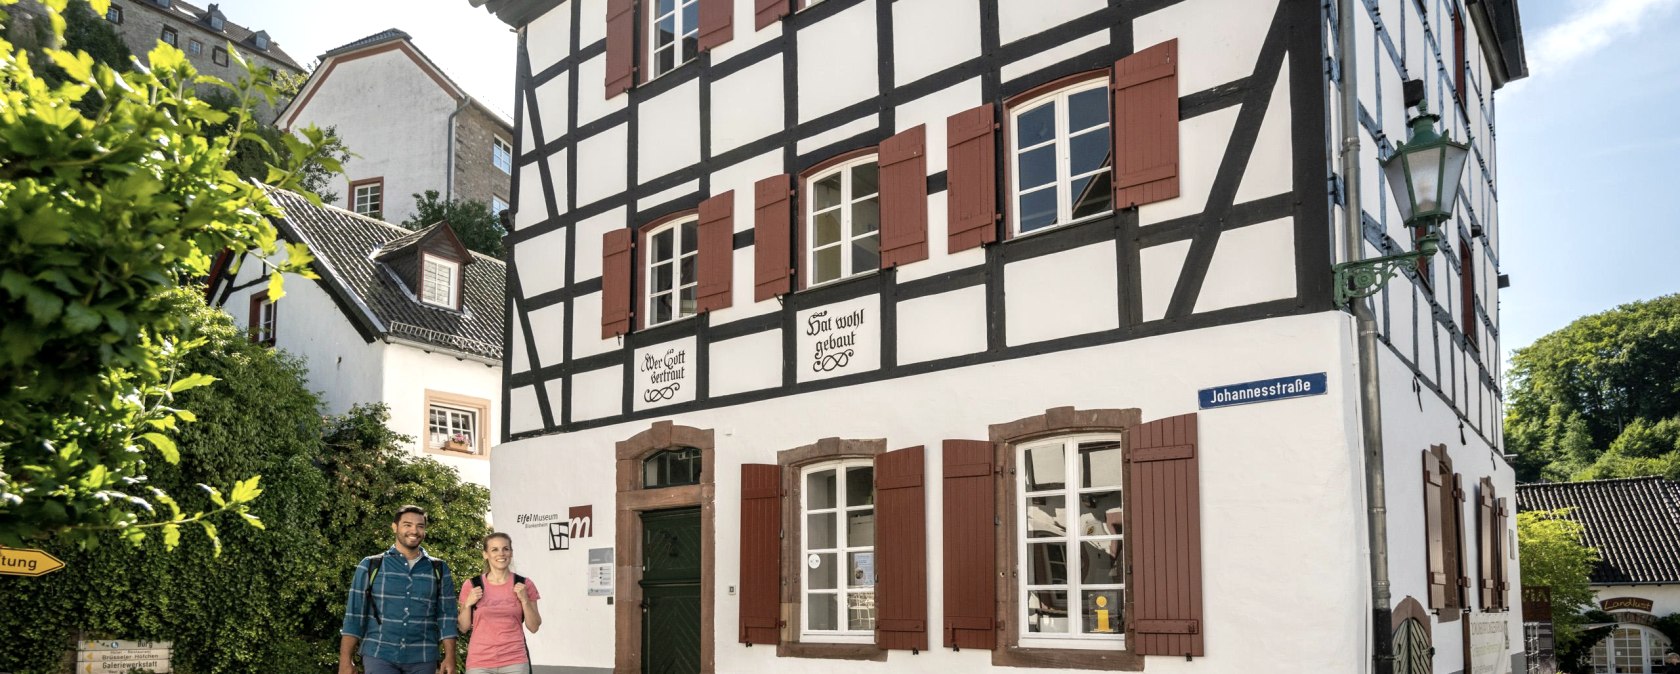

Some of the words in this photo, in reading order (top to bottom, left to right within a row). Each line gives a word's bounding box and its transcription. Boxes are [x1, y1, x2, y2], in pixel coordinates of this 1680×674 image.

[806, 310, 832, 336] Hat
[836, 308, 864, 330] wohl
[814, 331, 856, 360] gebaut
[641, 353, 663, 372] Wer
[664, 348, 686, 370] Gott
[1210, 378, 1311, 404] Johannesstraße
[516, 513, 533, 525] Eifel
[533, 513, 559, 522] Museum
[0, 555, 37, 571] tung
[1604, 598, 1651, 610] Landlust
[102, 660, 158, 669] Galeriewerkstatt
